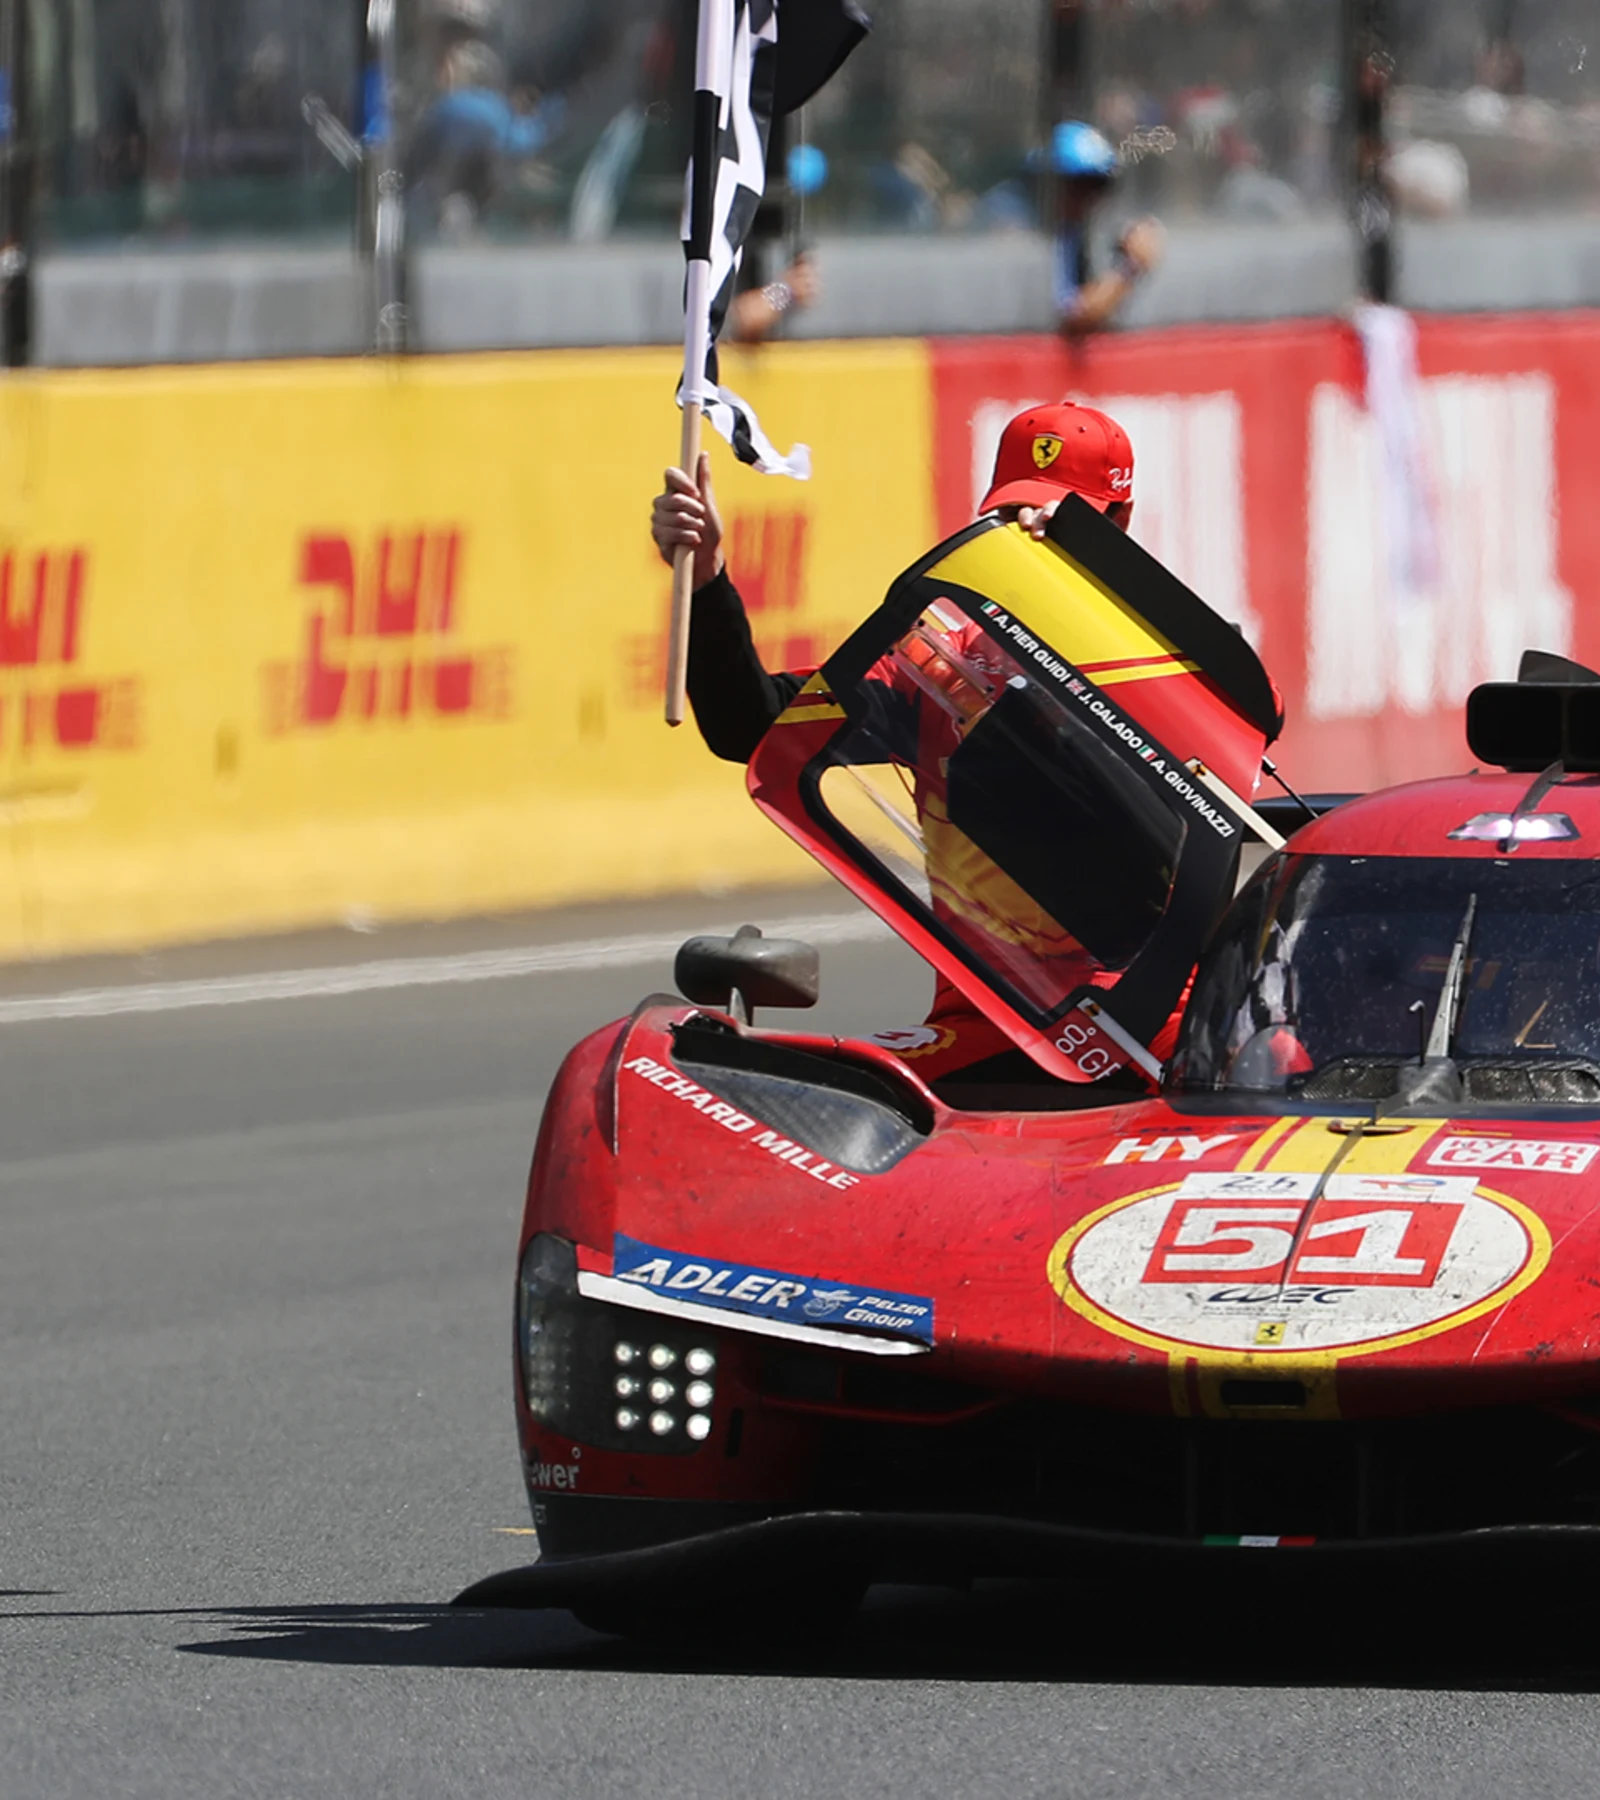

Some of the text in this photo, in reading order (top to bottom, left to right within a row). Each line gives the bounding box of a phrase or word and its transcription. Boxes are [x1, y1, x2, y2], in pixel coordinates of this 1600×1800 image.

[994, 614, 1235, 838] A. PIER GUIDI J. CALADO A. GIOVINAZZI
[623, 1056, 860, 1191] RICHARD MILLE
[1103, 1135, 1239, 1165] HY
[1440, 1149, 1579, 1169] CAR
[1449, 1140, 1587, 1154] HYPER
[1161, 1208, 1428, 1277] 51
[615, 1257, 807, 1310] ADLER
[1208, 1286, 1356, 1304] WEC
